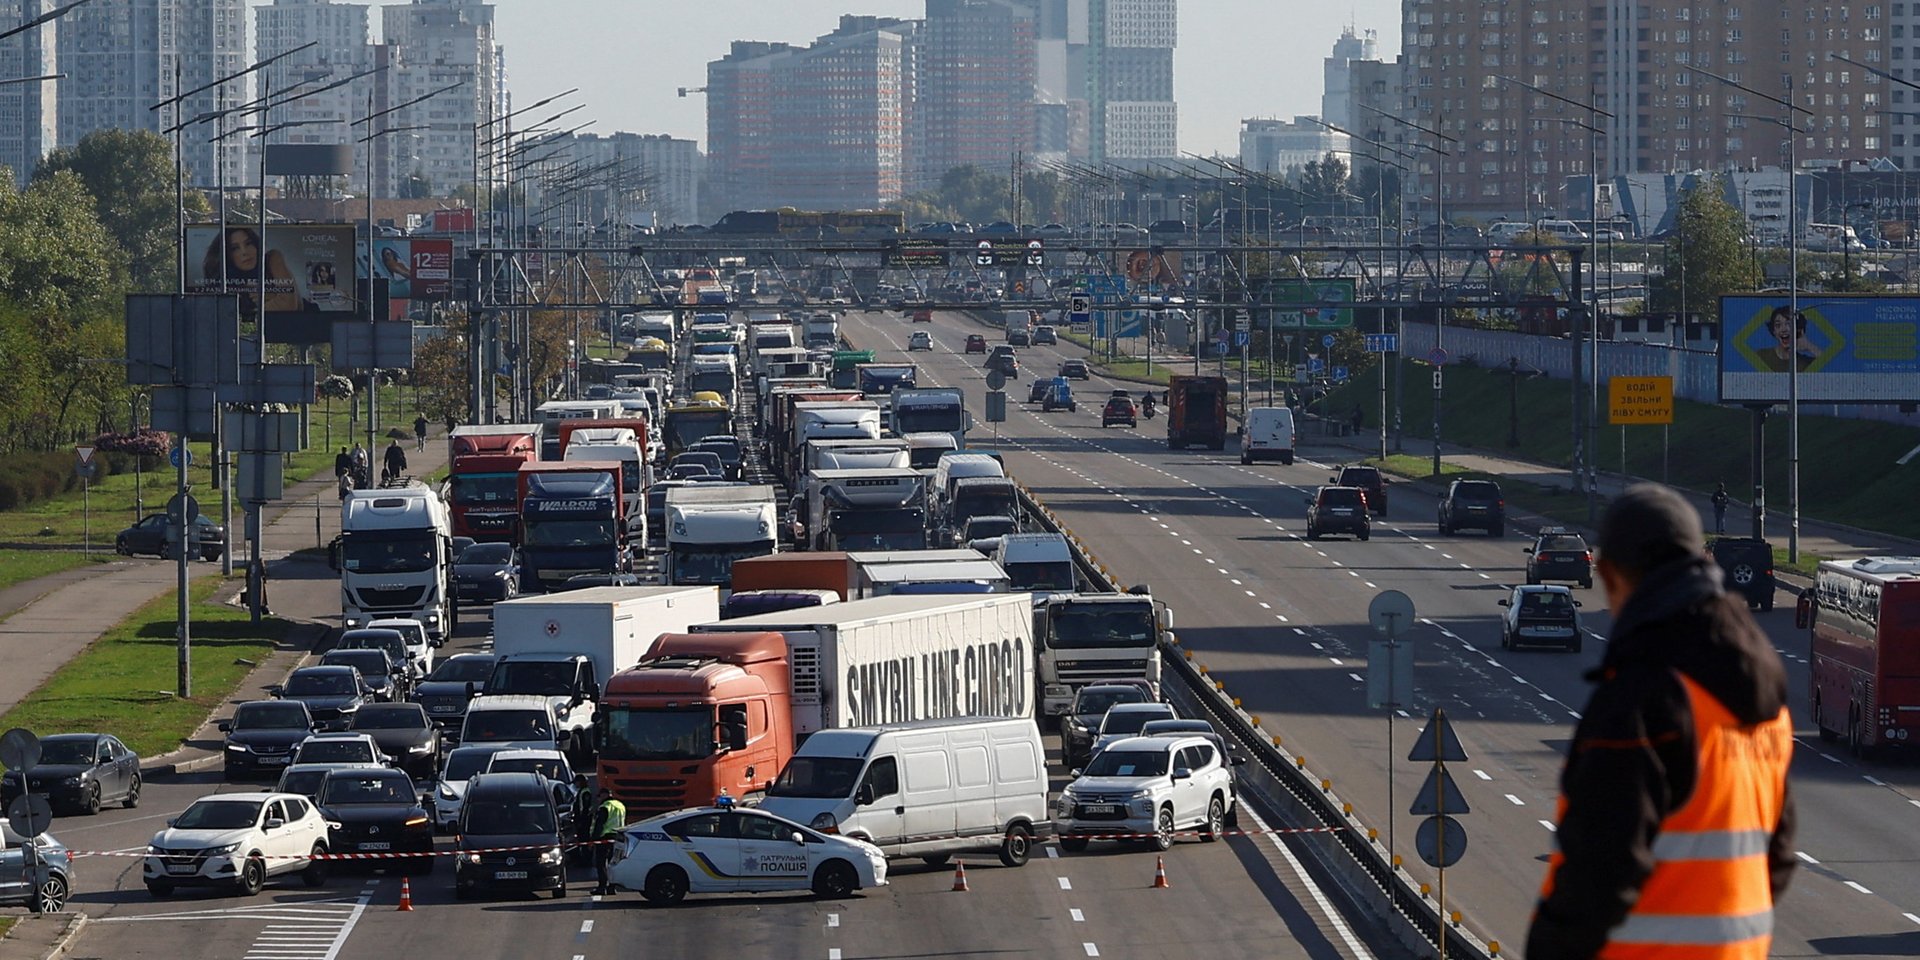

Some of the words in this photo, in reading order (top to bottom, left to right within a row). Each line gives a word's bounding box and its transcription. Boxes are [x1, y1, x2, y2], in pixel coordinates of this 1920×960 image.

[414, 253, 432, 268] 12
[1626, 382, 1656, 392] ВОДІЙ
[1621, 396, 1662, 405] ЗВІЛЬНИ
[1612, 408, 1635, 417] ЛІВУ
[1637, 408, 1670, 417] СМУГУ
[539, 500, 597, 512] WALDOR
[922, 648, 961, 721] LINE
[964, 637, 1026, 717] CARGO
[760, 862, 807, 873] ПОЛІЦІЯ
